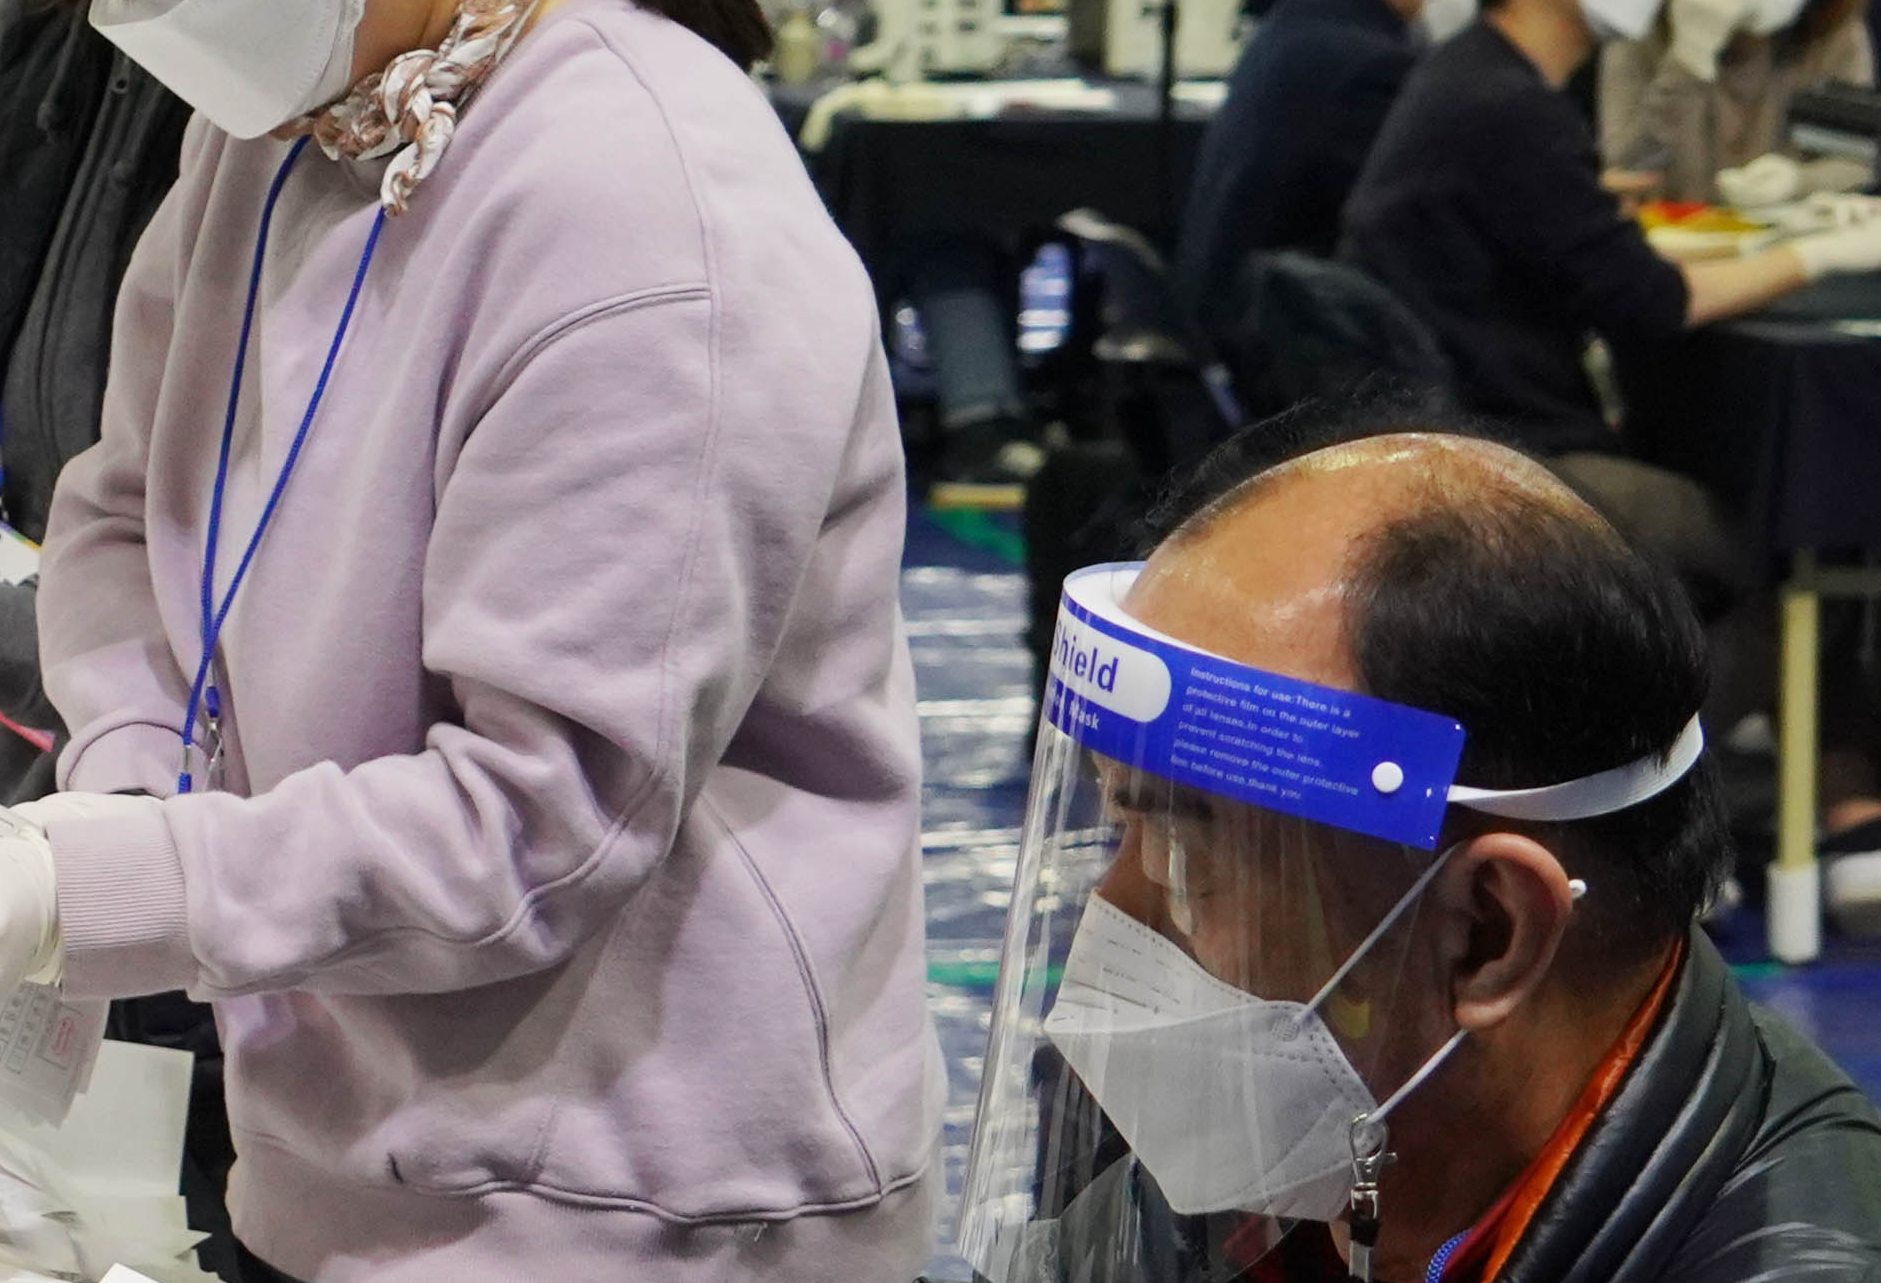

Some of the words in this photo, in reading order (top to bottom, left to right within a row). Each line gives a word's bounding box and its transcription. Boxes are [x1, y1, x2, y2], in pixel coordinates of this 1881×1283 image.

[1186, 686, 1237, 707] protective
[1240, 699, 1259, 712] film
[1262, 707, 1276, 718] on
[1279, 711, 1296, 722] the
[1300, 717, 1328, 730] outer
[1331, 723, 1359, 738] layer
[1191, 667, 1250, 692] Instructions
[1254, 684, 1268, 696] for
[1330, 704, 1340, 714] is
[1343, 710, 1351, 718] a
[1178, 721, 1217, 739] prevent
[1277, 748, 1294, 760] the
[1182, 703, 1193, 712] of
[1194, 707, 1207, 716] all
[1261, 726, 1290, 739] order
[1293, 733, 1303, 743] to
[1173, 739, 1207, 754] please
[1210, 748, 1249, 766] remove
[1252, 760, 1269, 772] the
[1272, 766, 1300, 780] outer
[1303, 775, 1359, 796] protective
[1191, 762, 1223, 779] before
